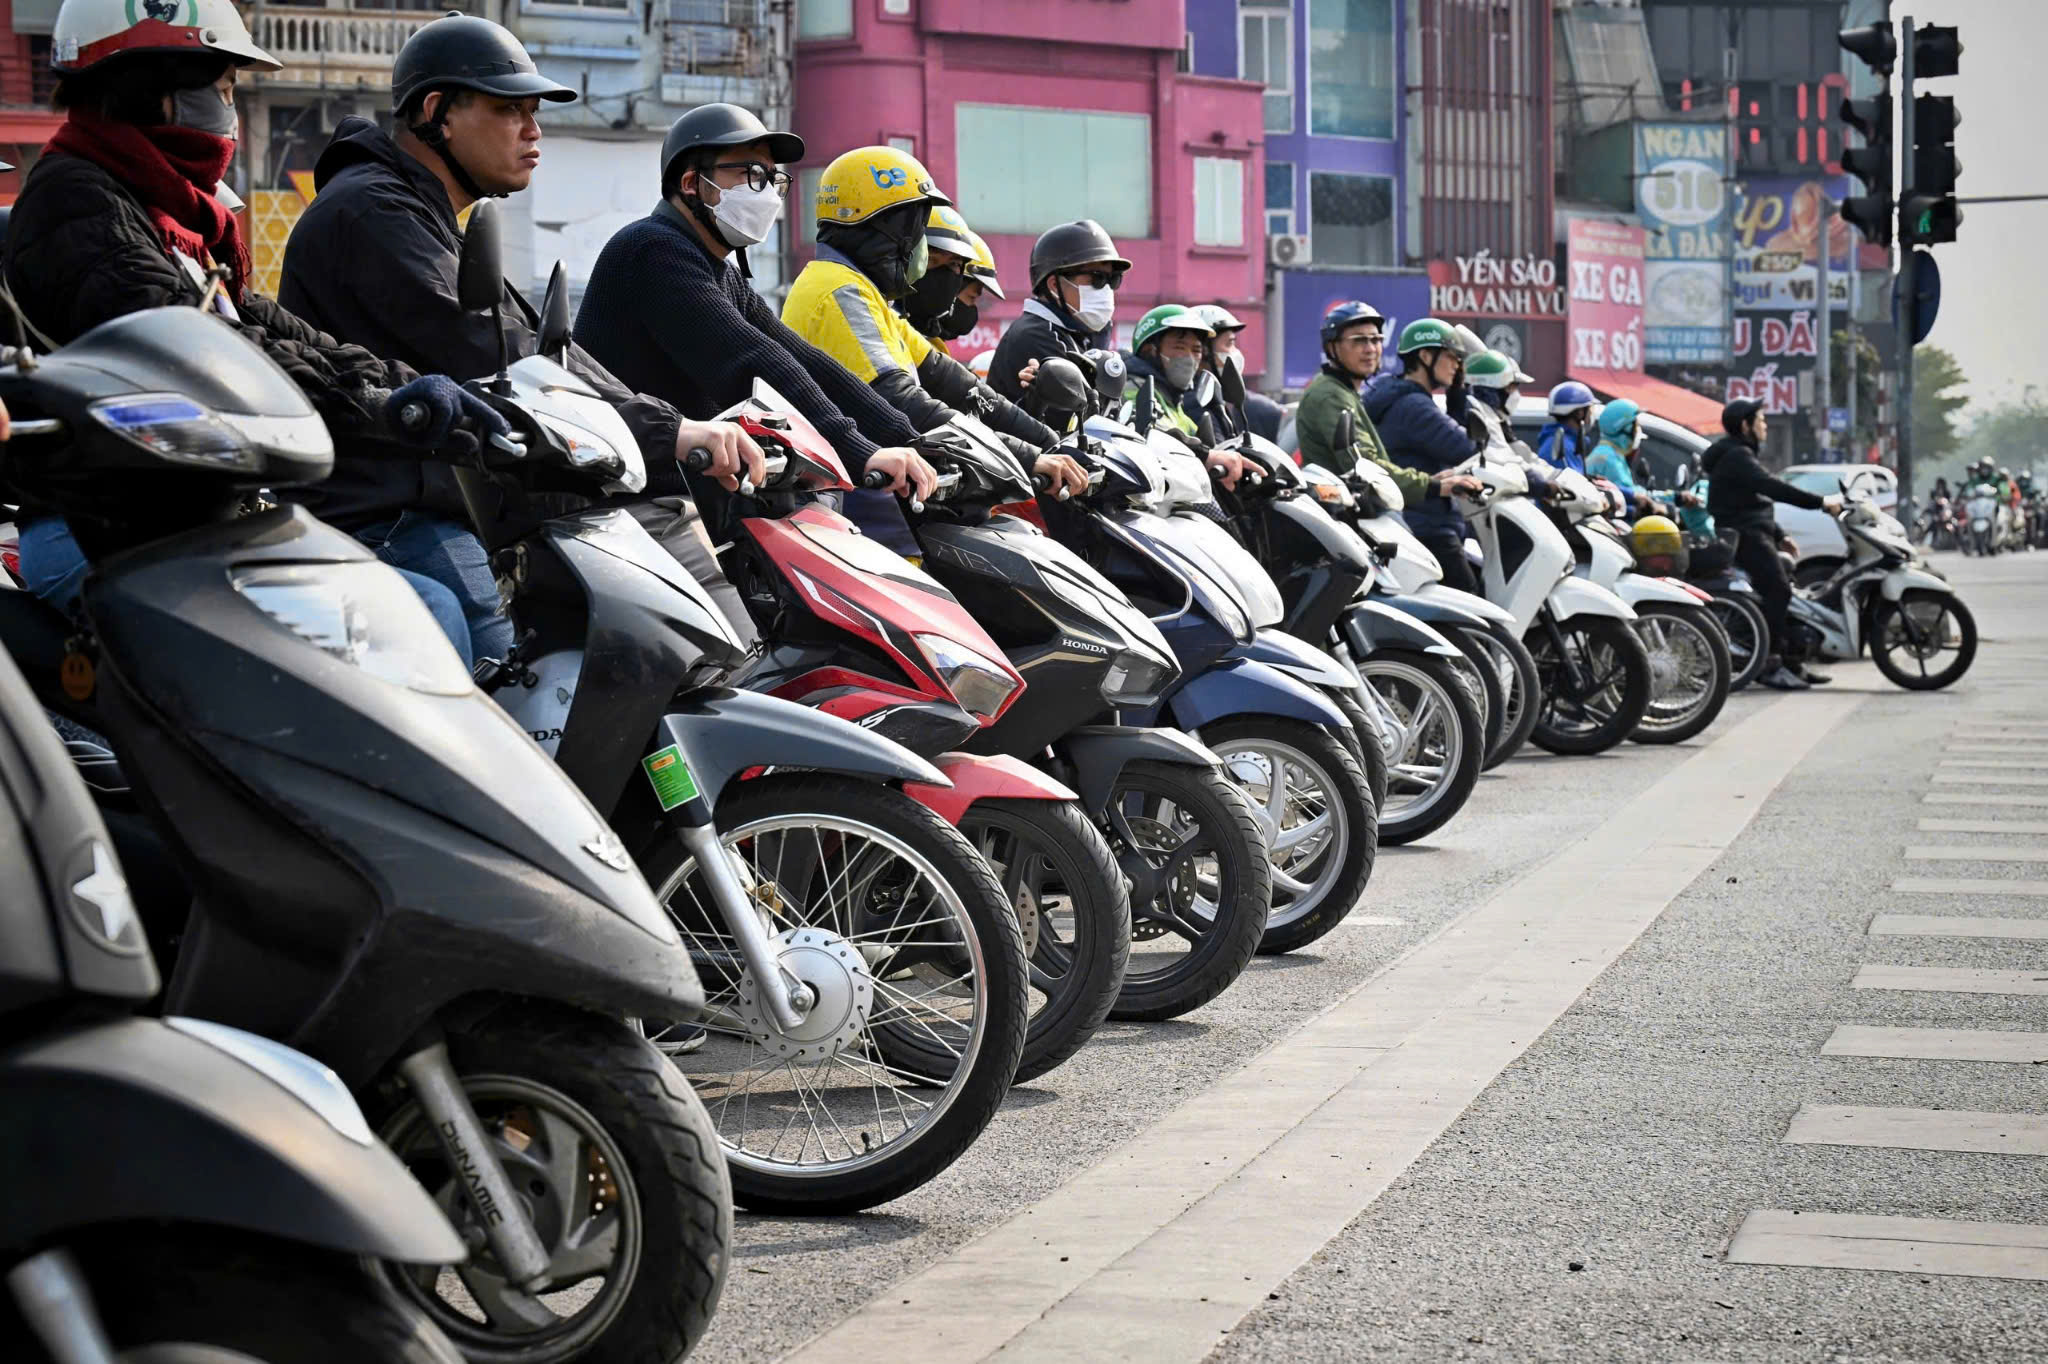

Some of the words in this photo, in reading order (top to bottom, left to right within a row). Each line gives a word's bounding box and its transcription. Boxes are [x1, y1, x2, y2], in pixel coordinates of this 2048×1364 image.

[869, 165, 906, 189] be
[1456, 248, 1505, 285] YẾN
[1572, 260, 1605, 301] XE
[1609, 265, 1643, 306] GA
[1430, 285, 1479, 313] HOA
[1481, 288, 1531, 314] ANH
[1414, 329, 1441, 342] Grab
[1573, 327, 1606, 368] XE
[1610, 315, 1641, 372] SỐ
[1062, 638, 1109, 655] HONDA
[441, 1121, 503, 1227] DYNAMIC
